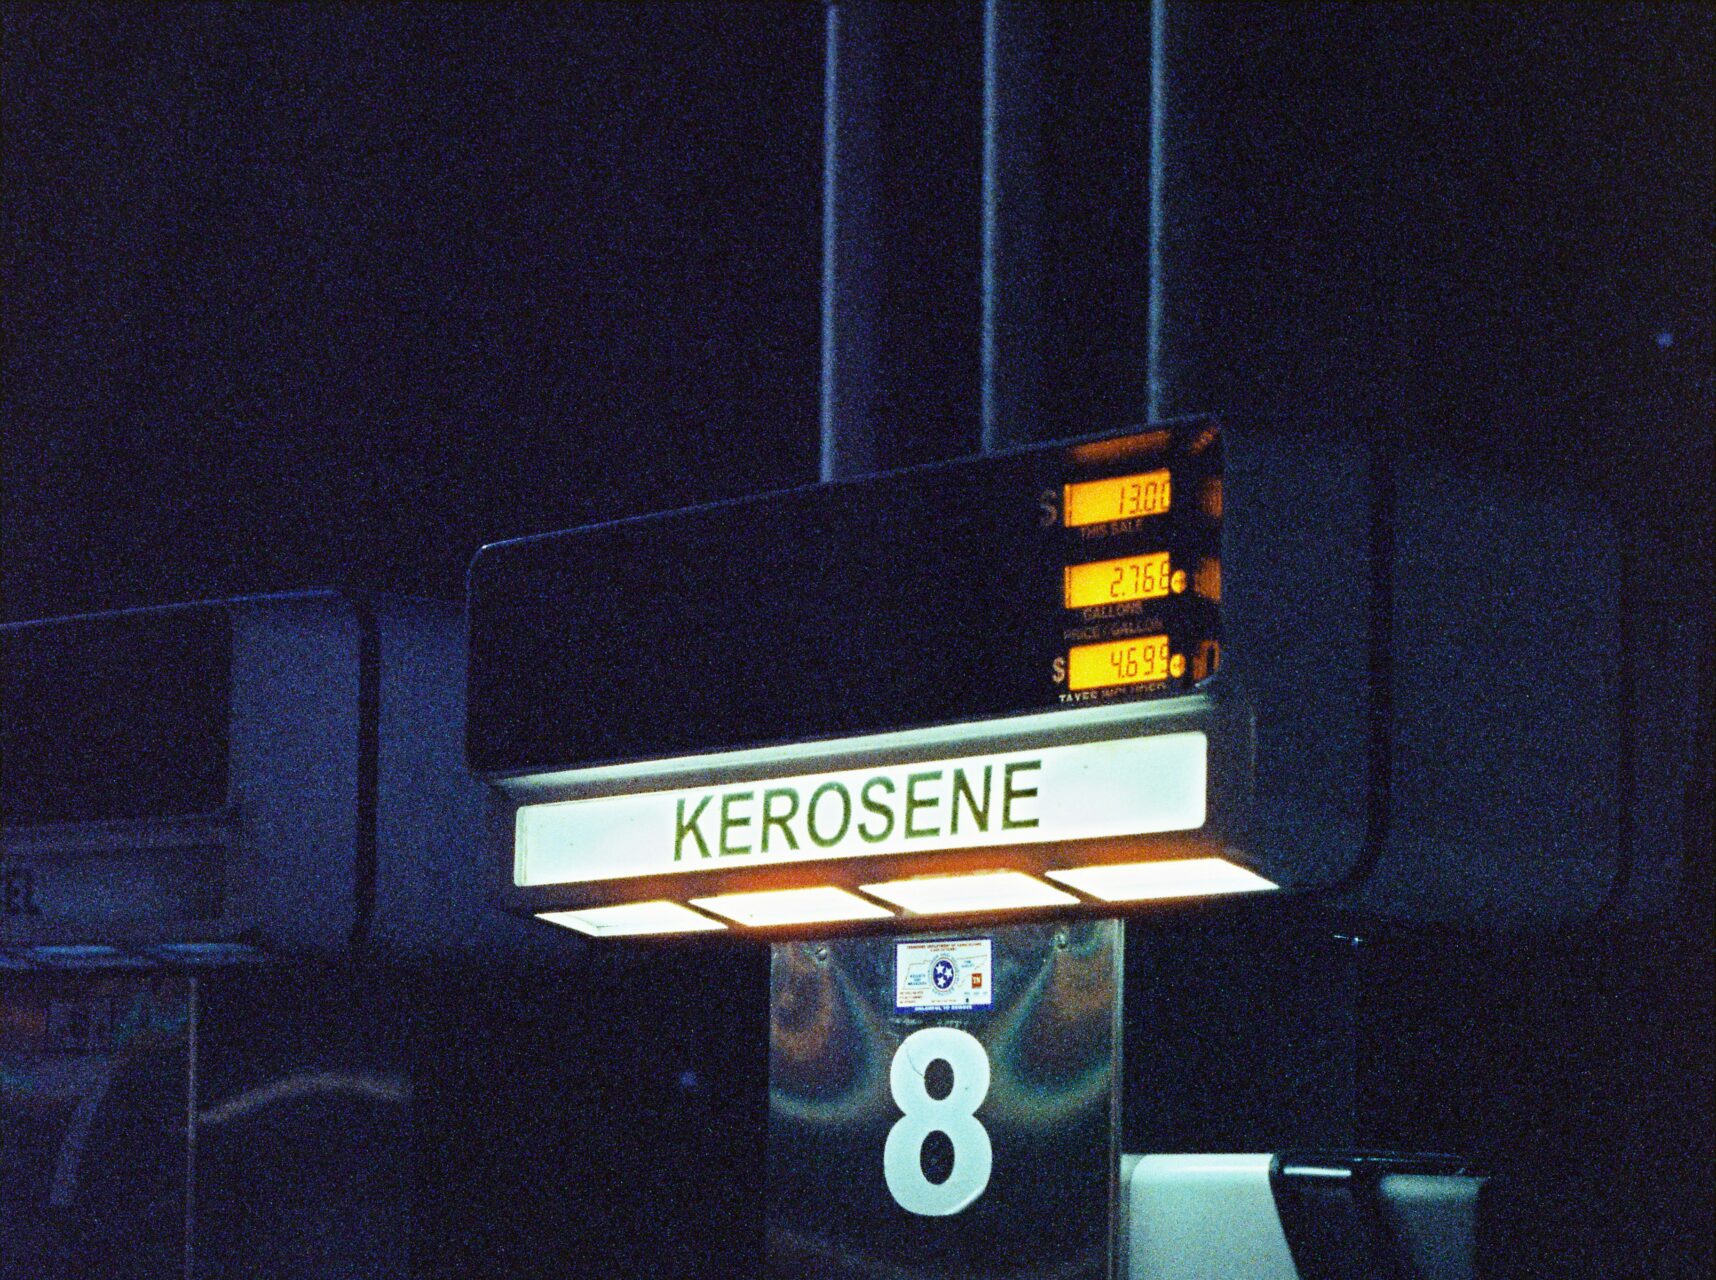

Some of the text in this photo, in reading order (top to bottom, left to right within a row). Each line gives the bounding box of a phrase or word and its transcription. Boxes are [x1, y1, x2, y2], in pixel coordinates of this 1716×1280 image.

[1052, 656, 1065, 684] $
[673, 759, 1042, 862] KEROSENE
[883, 1026, 992, 1217] 8
